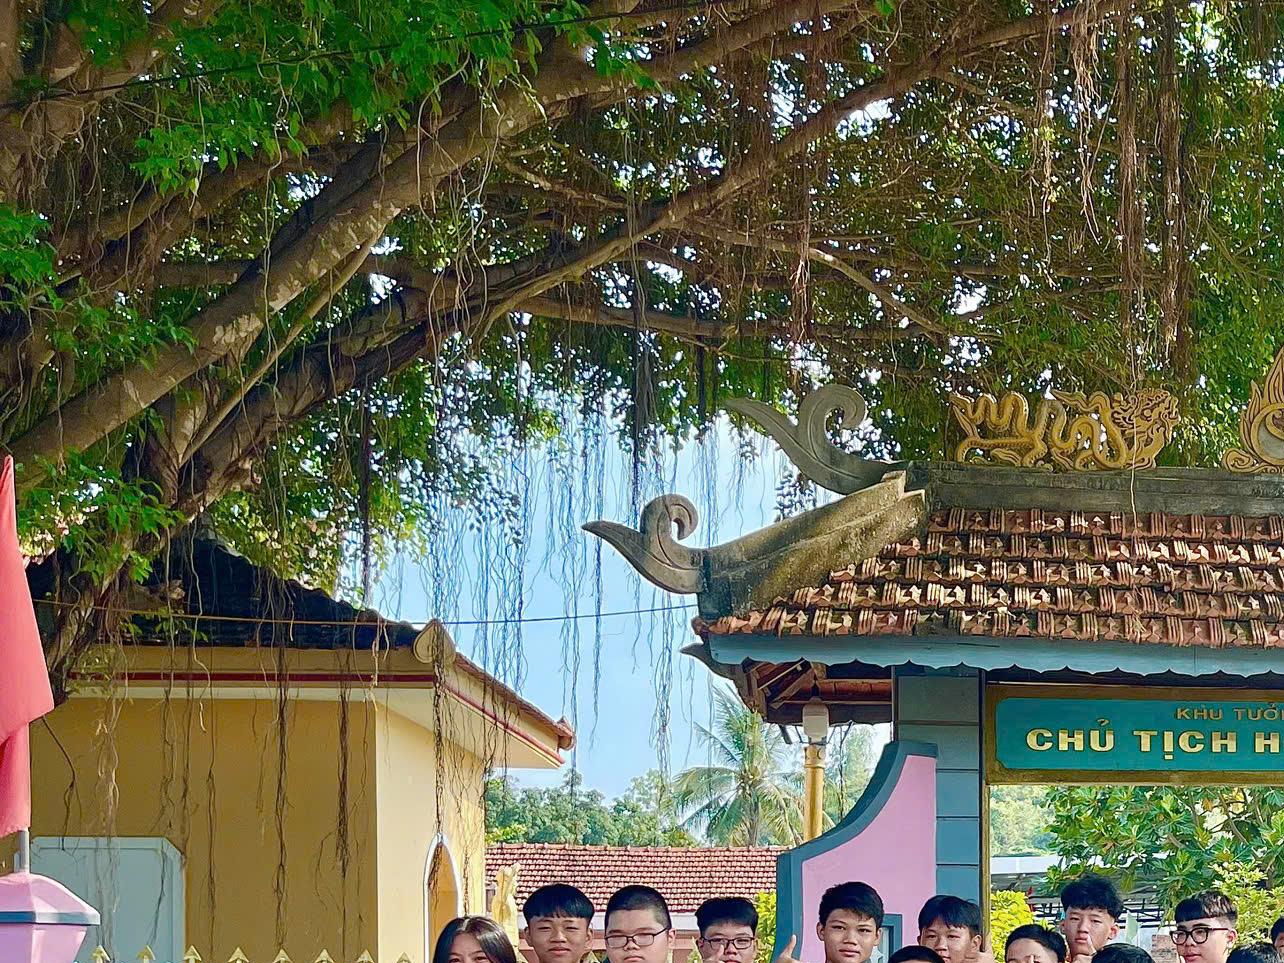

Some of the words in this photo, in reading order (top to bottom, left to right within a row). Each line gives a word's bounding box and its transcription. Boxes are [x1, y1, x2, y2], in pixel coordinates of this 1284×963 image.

[1175, 707, 1223, 721] KHU
[1026, 718, 1115, 752] CHỦ
[1133, 730, 1237, 760] TỊCH
